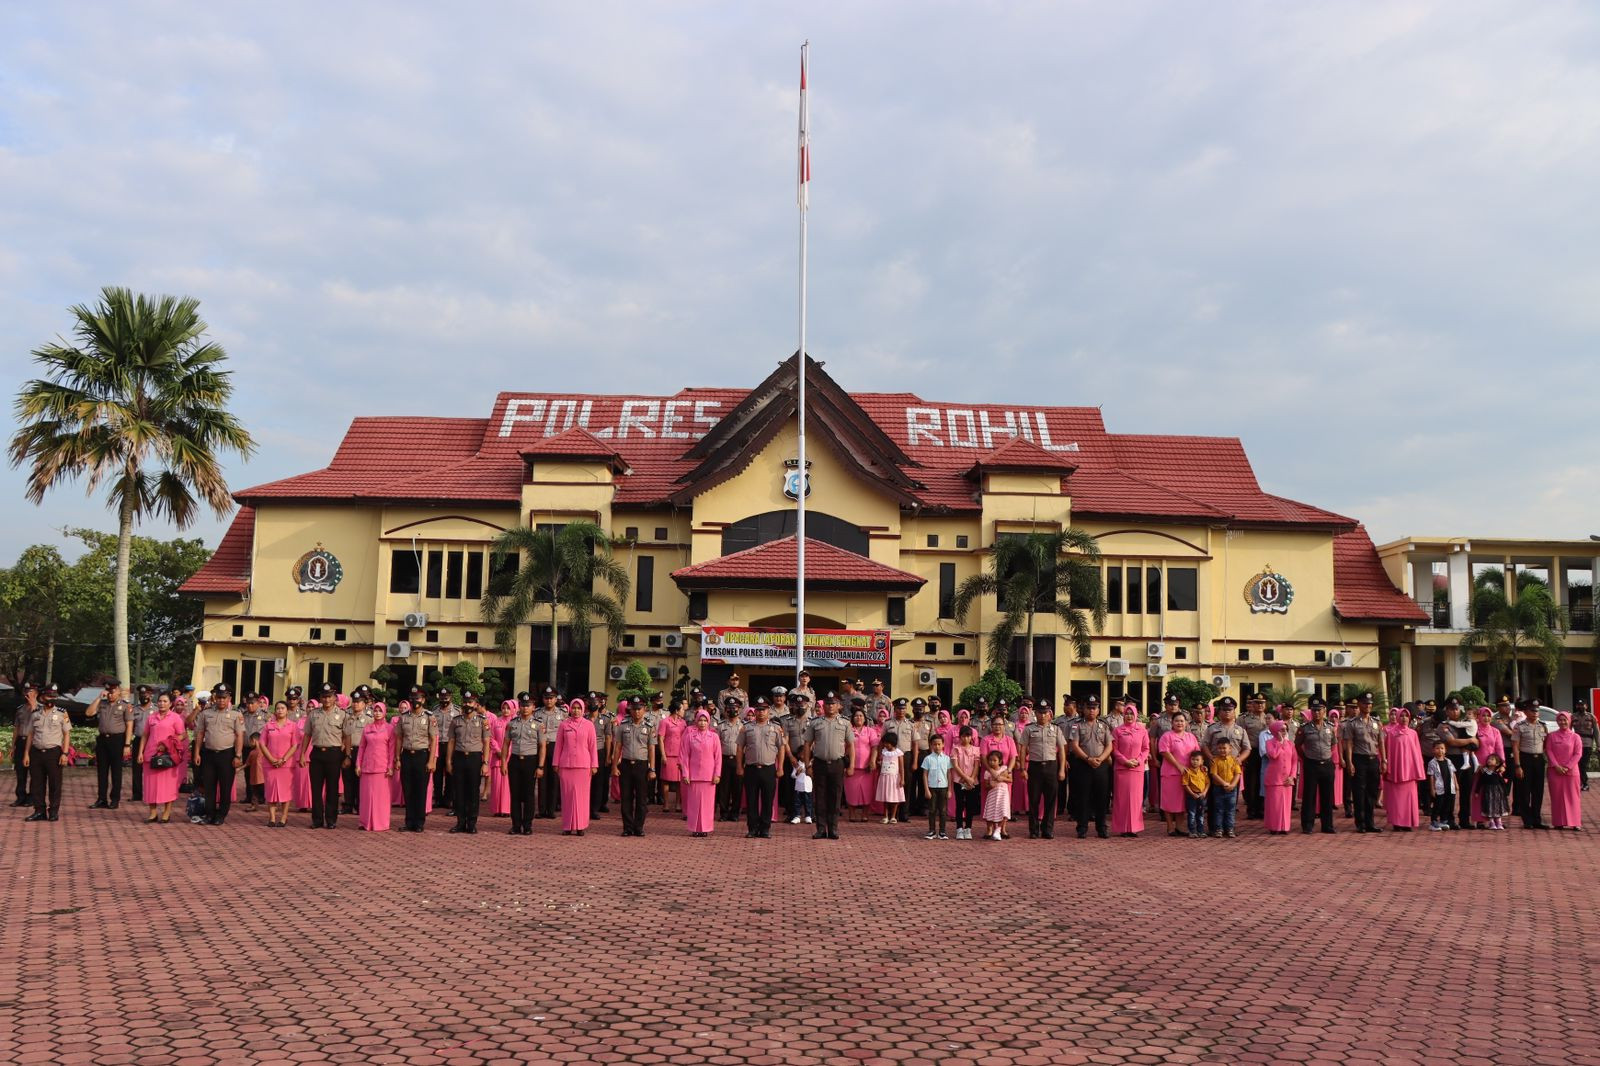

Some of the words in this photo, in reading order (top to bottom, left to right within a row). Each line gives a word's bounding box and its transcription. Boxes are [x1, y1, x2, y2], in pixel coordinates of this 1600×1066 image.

[498, 399, 721, 439] POLRES
[906, 407, 1079, 451] ROHIL
[724, 632, 760, 644] UPACARA
[761, 633, 797, 646] LAPORAN
[705, 647, 738, 656] PERSONEL
[739, 648, 763, 657] POLRES
[764, 649, 787, 658] ROKAN
[807, 650, 834, 660] PERIODE
[840, 651, 867, 660] JANUARI
[867, 652, 887, 661] 2023
